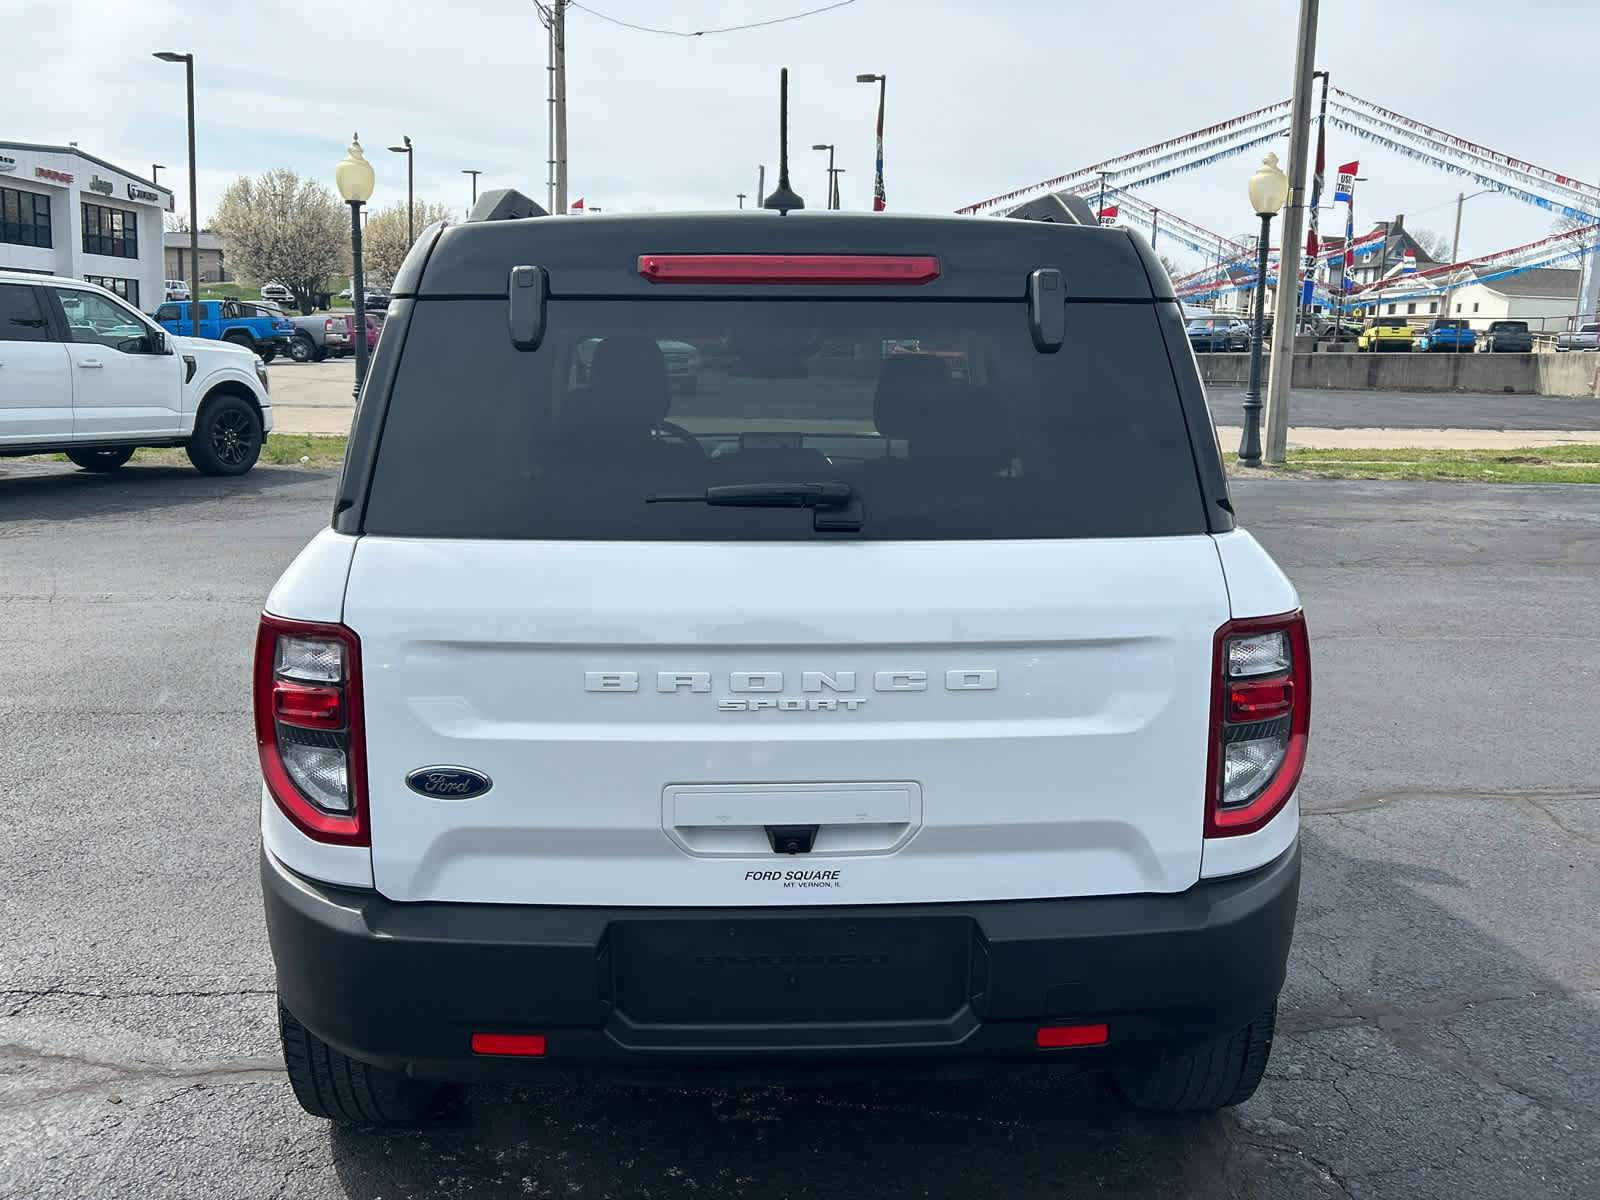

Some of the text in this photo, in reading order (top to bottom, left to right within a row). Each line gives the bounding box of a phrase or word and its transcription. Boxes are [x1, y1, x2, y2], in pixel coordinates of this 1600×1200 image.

[584, 670, 998, 694] BRONCO
[718, 698, 867, 712] SPORT
[424, 772, 472, 792] Ford
[744, 870, 841, 881] FORD SQUARE
